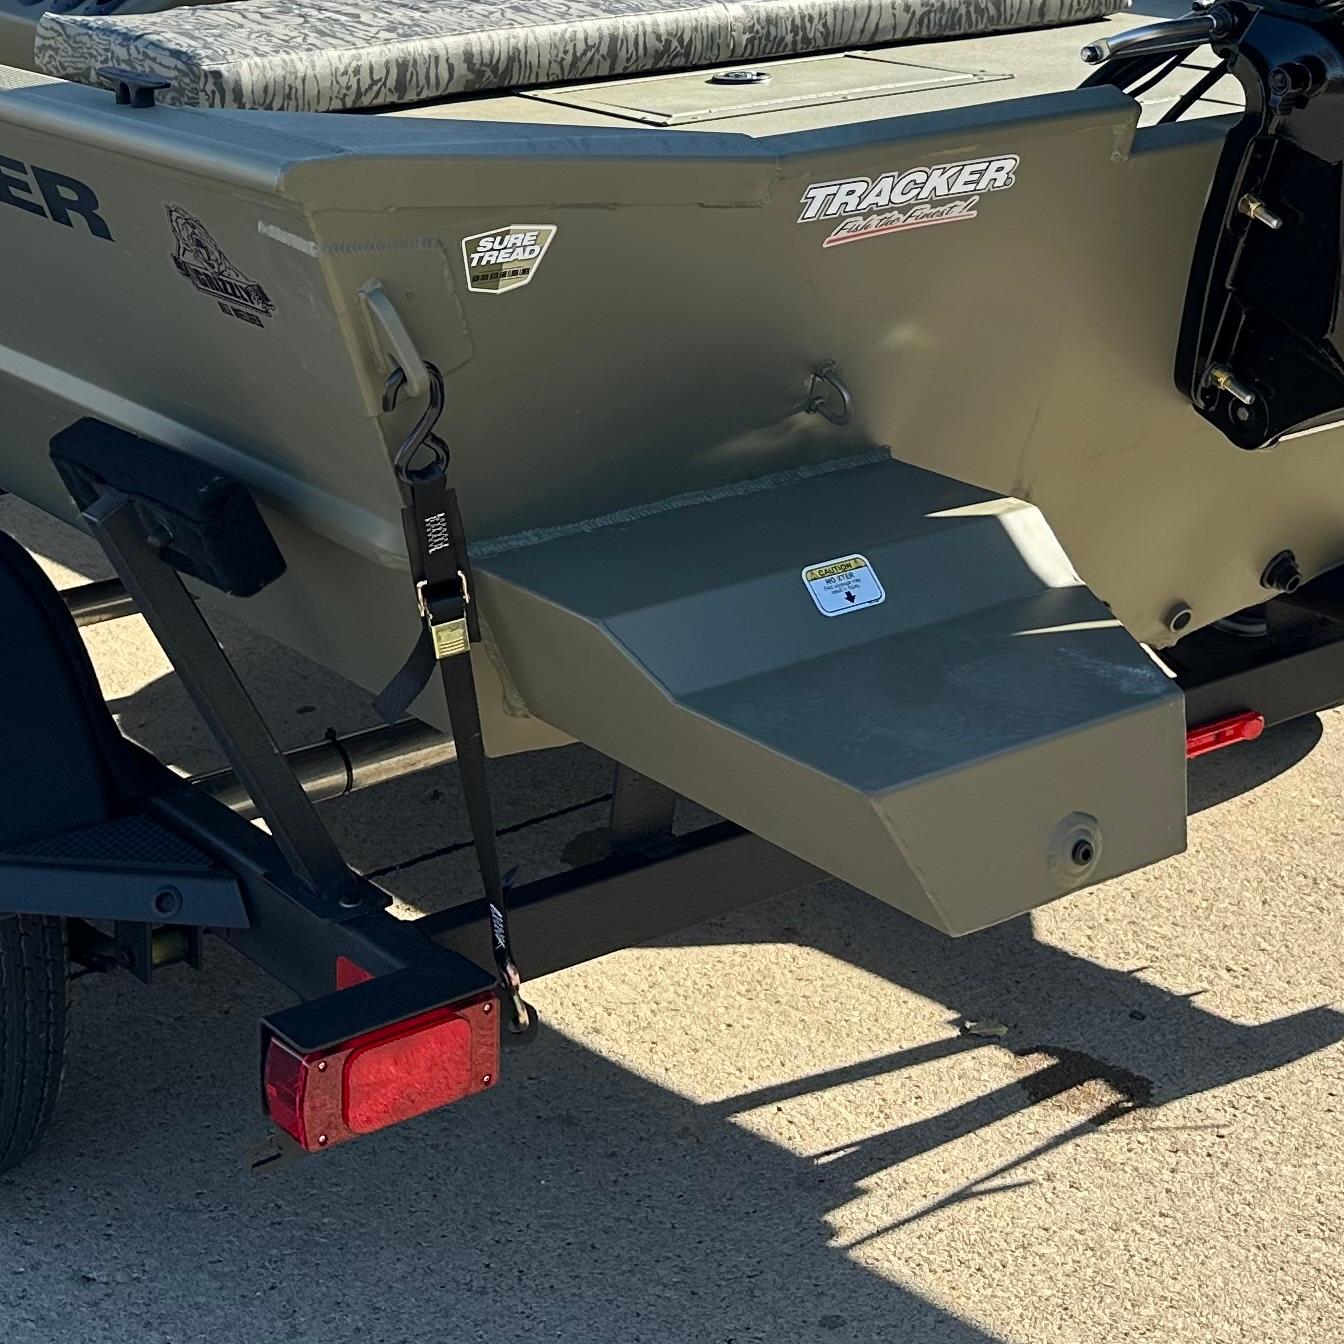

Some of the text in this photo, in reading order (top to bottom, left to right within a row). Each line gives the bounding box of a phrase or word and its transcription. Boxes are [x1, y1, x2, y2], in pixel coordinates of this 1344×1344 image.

[799, 156, 1019, 222] TRACKER
[476, 230, 540, 252] SURE
[469, 244, 541, 267] TREAD
[817, 561, 853, 577] CAUTION
